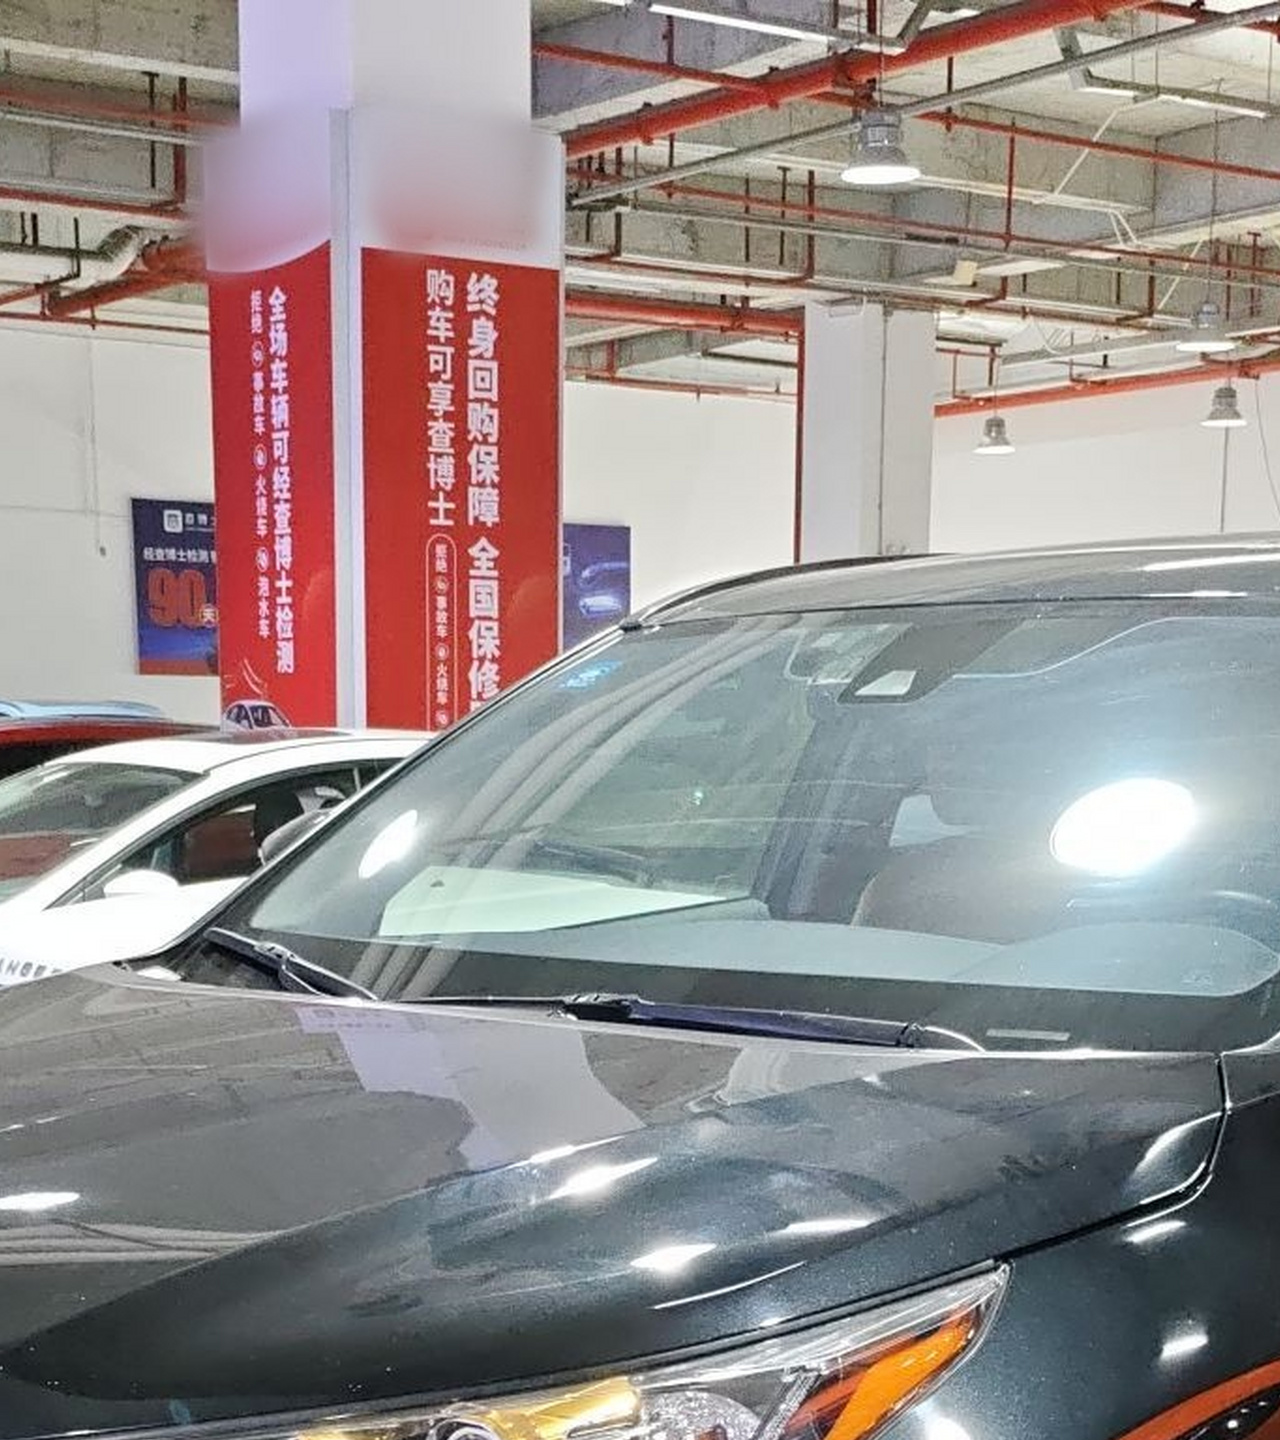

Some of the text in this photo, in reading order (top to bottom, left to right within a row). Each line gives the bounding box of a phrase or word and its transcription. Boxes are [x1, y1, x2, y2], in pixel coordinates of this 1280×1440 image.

[269, 285, 295, 673] 全场车辆可经查博士检测
[426, 269, 455, 526] 购车可享查博士
[466, 272, 501, 712] 终身回购保障 全国保修
[148, 568, 206, 628] 90
